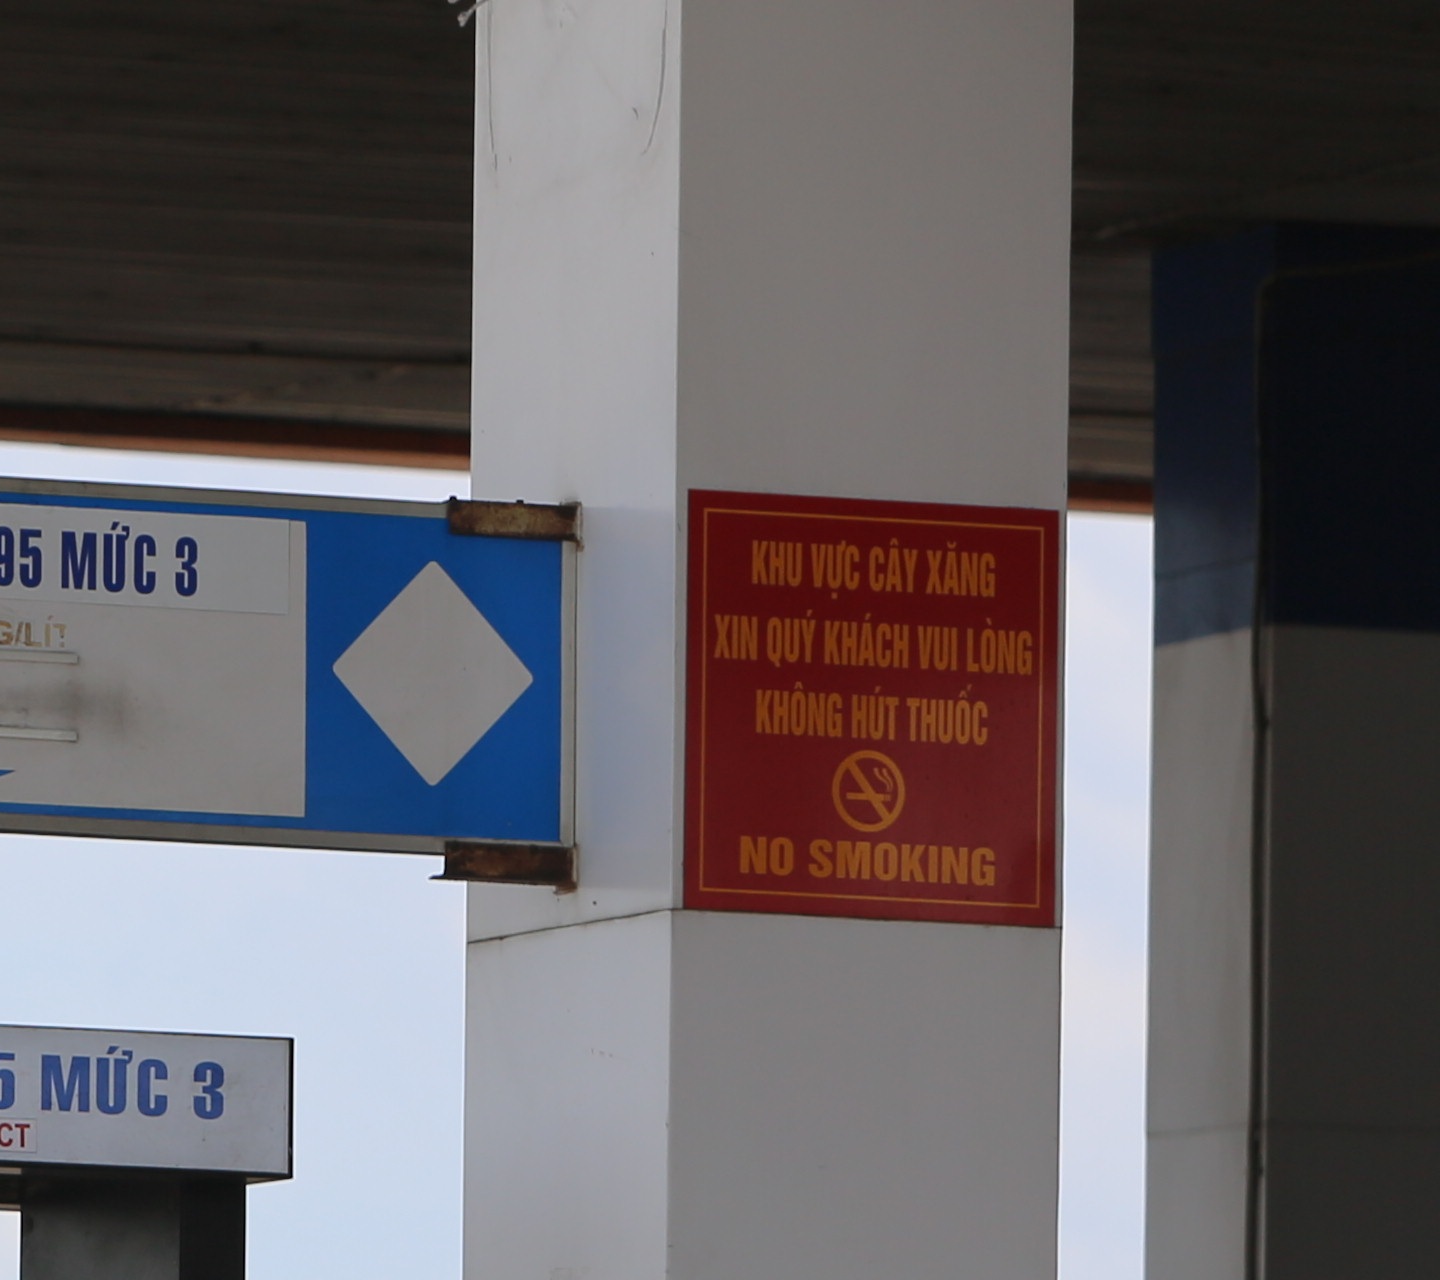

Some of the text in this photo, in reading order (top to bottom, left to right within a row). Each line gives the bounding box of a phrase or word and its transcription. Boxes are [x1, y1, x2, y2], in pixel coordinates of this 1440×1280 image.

[61, 520, 157, 595] MỨC
[175, 537, 198, 597] 3
[751, 538, 997, 600] KHU VỰC CÂY XĂNG
[714, 609, 1033, 676] XIN QUÝ KHÁCH VUI LÒNG
[755, 681, 989, 746] KHÔNG HÚT THUỐC
[739, 835, 996, 888] NO SMOKING
[41, 1045, 169, 1118] MỨC
[193, 1060, 226, 1120] 3
